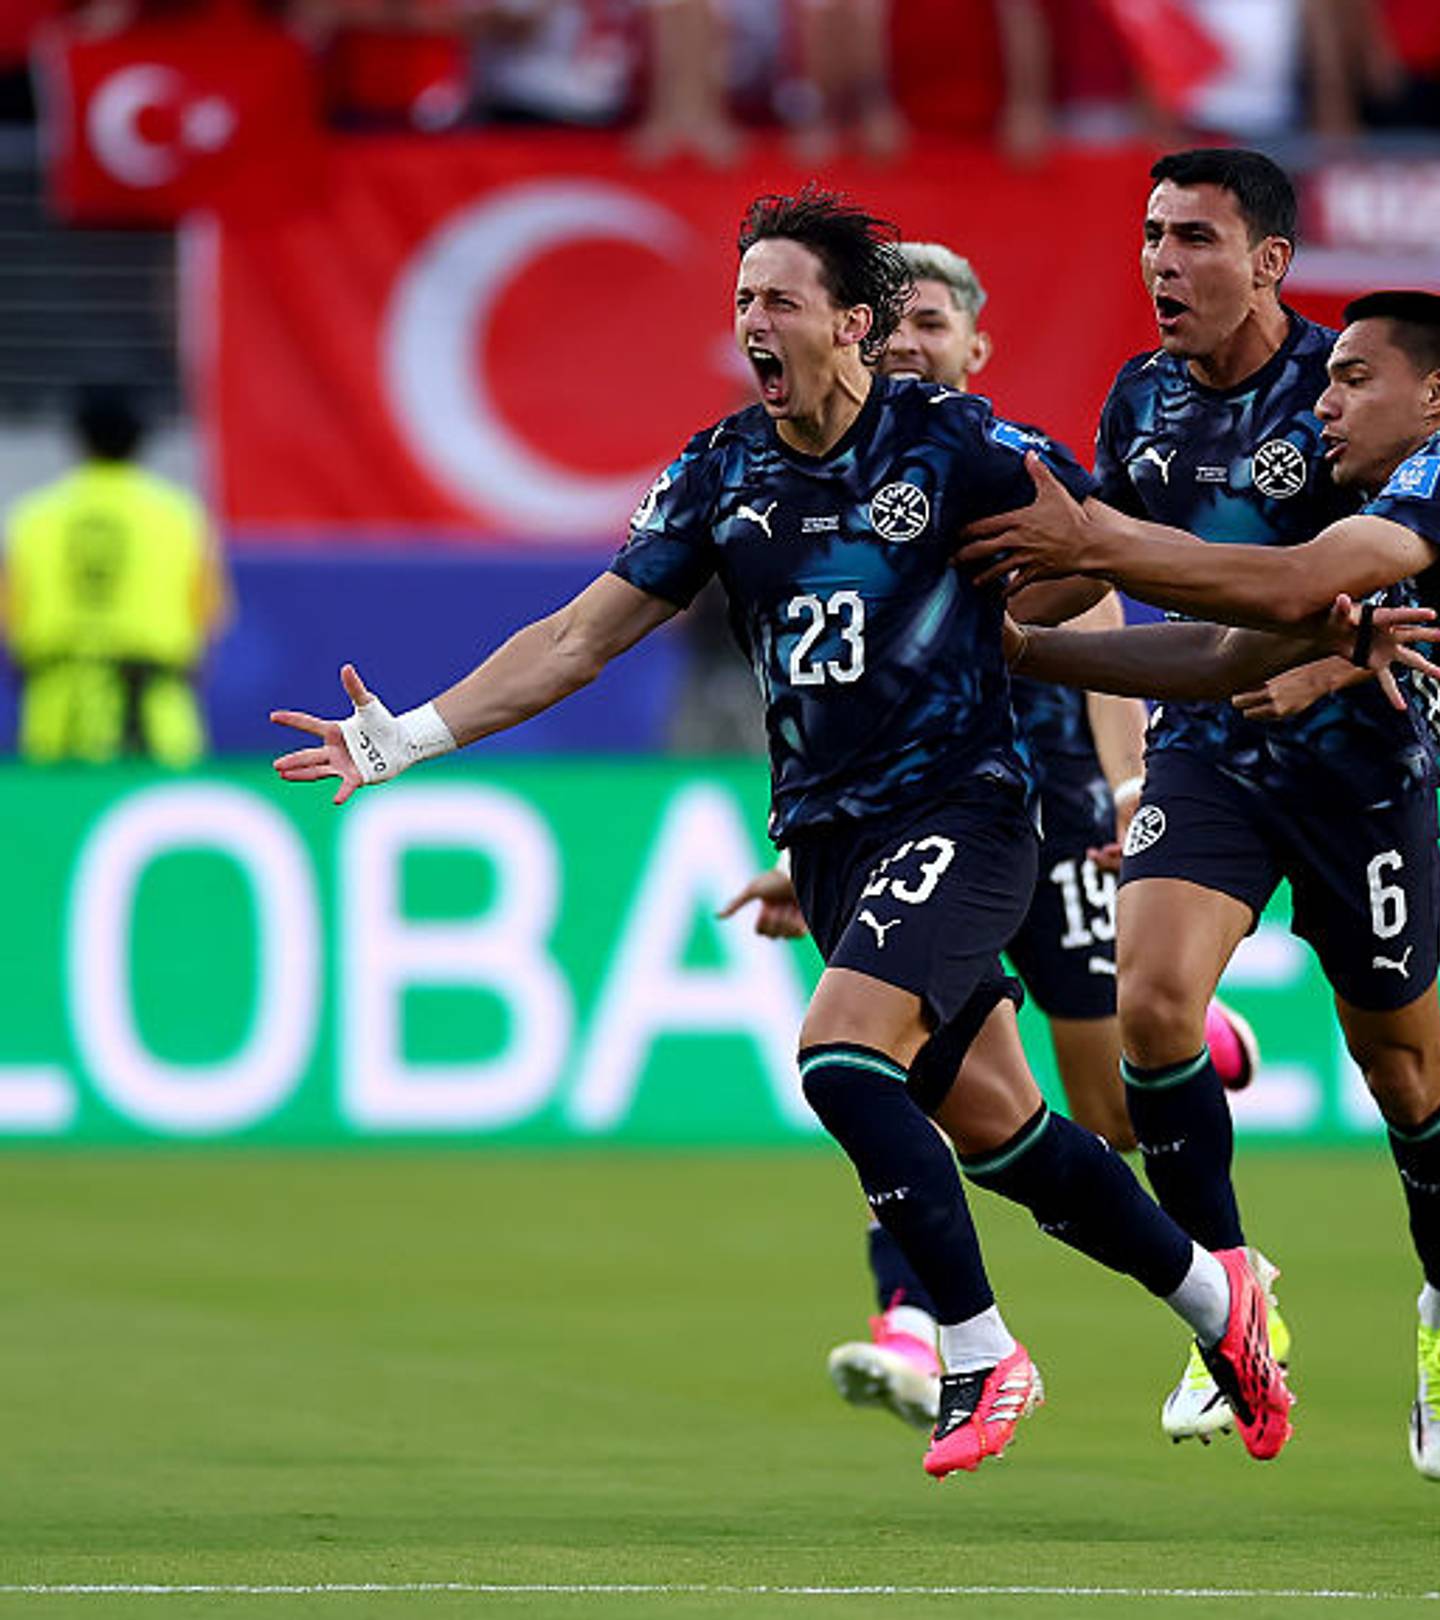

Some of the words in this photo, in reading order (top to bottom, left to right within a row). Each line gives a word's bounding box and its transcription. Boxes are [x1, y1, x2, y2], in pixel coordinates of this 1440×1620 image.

[787, 589, 866, 686] 23
[1049, 858, 1118, 950] 19
[1366, 849, 1408, 940] 6
[0, 776, 848, 1135] OBA
